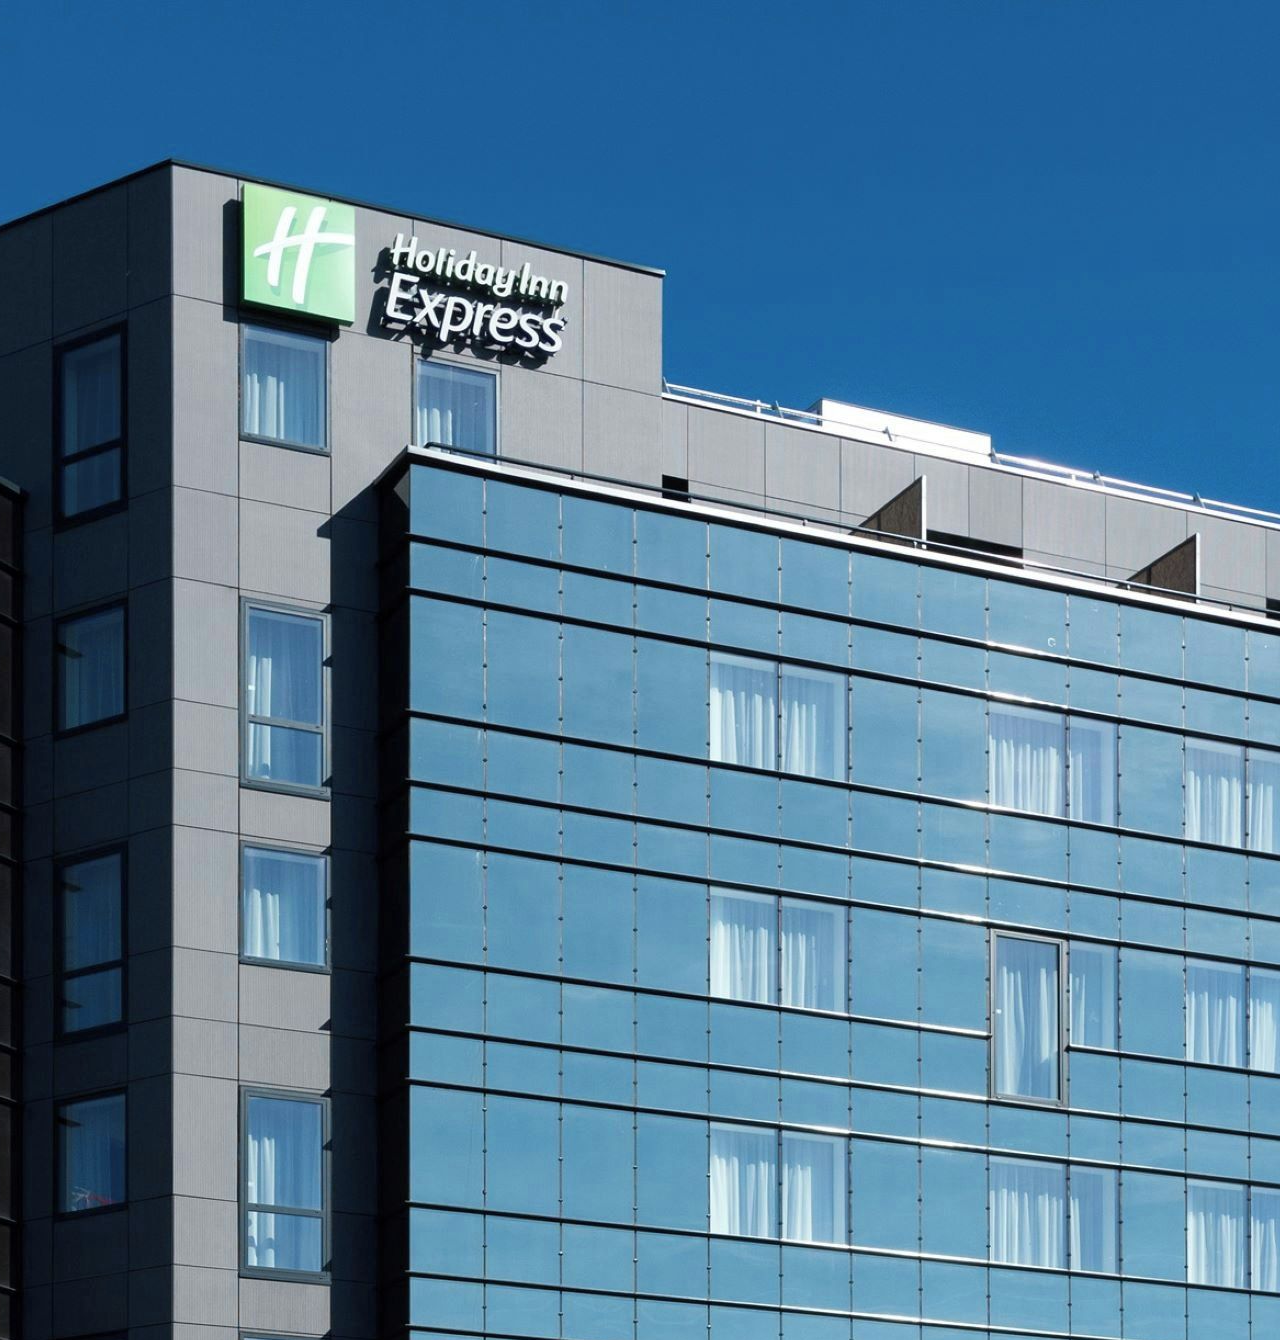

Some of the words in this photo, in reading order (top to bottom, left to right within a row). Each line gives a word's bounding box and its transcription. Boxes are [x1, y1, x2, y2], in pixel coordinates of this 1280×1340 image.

[390, 233, 516, 297] Holiday
[519, 262, 569, 303] Inn
[386, 272, 565, 352] Express
